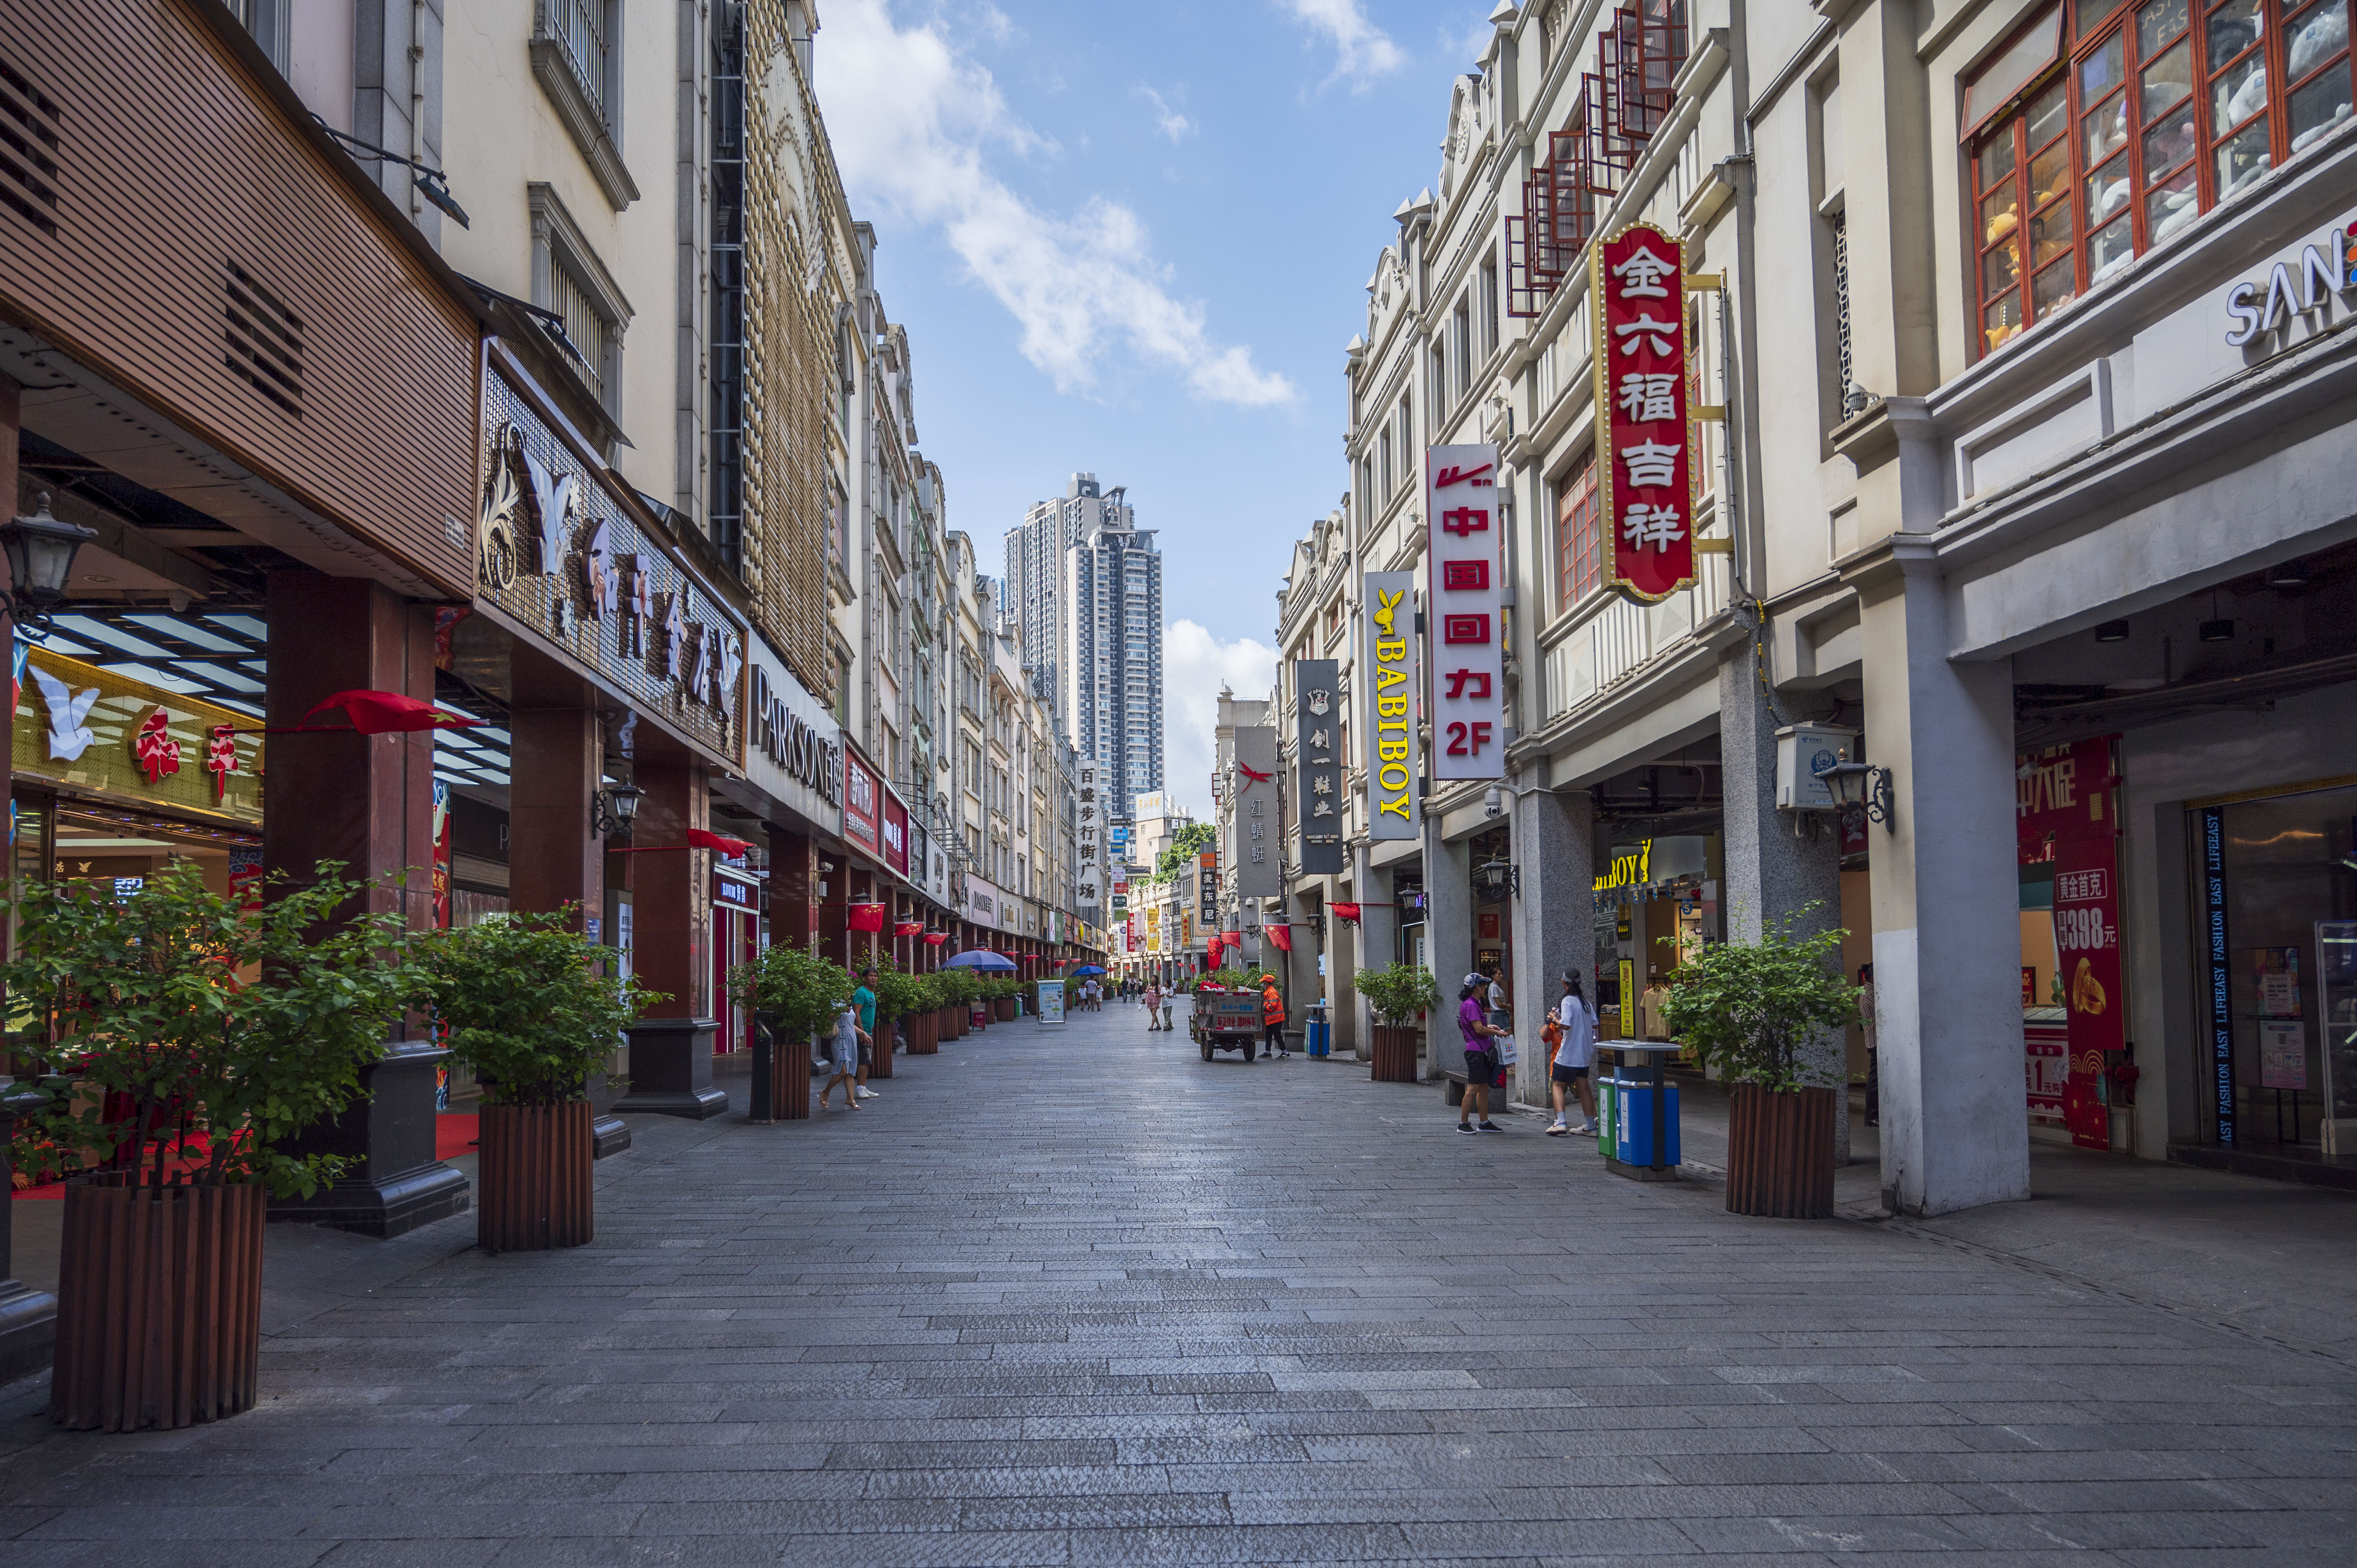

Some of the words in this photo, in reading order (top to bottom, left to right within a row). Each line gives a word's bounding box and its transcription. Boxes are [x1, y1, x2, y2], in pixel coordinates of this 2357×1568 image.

[2226, 228, 2344, 346] SAN
[1612, 245, 1686, 553] 金六福吉祥
[1443, 506, 1491, 698] 中国回力
[751, 664, 823, 795] PARKSON
[1376, 637, 1410, 820] BABIBOY
[1446, 721, 1492, 755] 2F
[849, 761, 874, 820] 都市丽人
[1309, 729, 1333, 817] 创一鞋业
[1080, 767, 1096, 899] 百盛步行街广场
[1251, 799, 1264, 863] 红蜻蜓
[2207, 814, 2220, 871] LIFEEASY
[1203, 873, 1214, 920] 麦东尼
[2060, 872, 2102, 898] 黄金首克
[2210, 877, 2222, 905] EASY
[2212, 911, 2224, 961] FASHION
[1217, 1016, 1235, 1027] 环卫作业
[1237, 1016, 1255, 1027] 随时停车
[2213, 967, 2228, 1023] LIFEEASY
[2036, 1046, 2053, 1055] 银饰
[2217, 1029, 2229, 1058] EASY
[2218, 1064, 2231, 1115] FASHION
